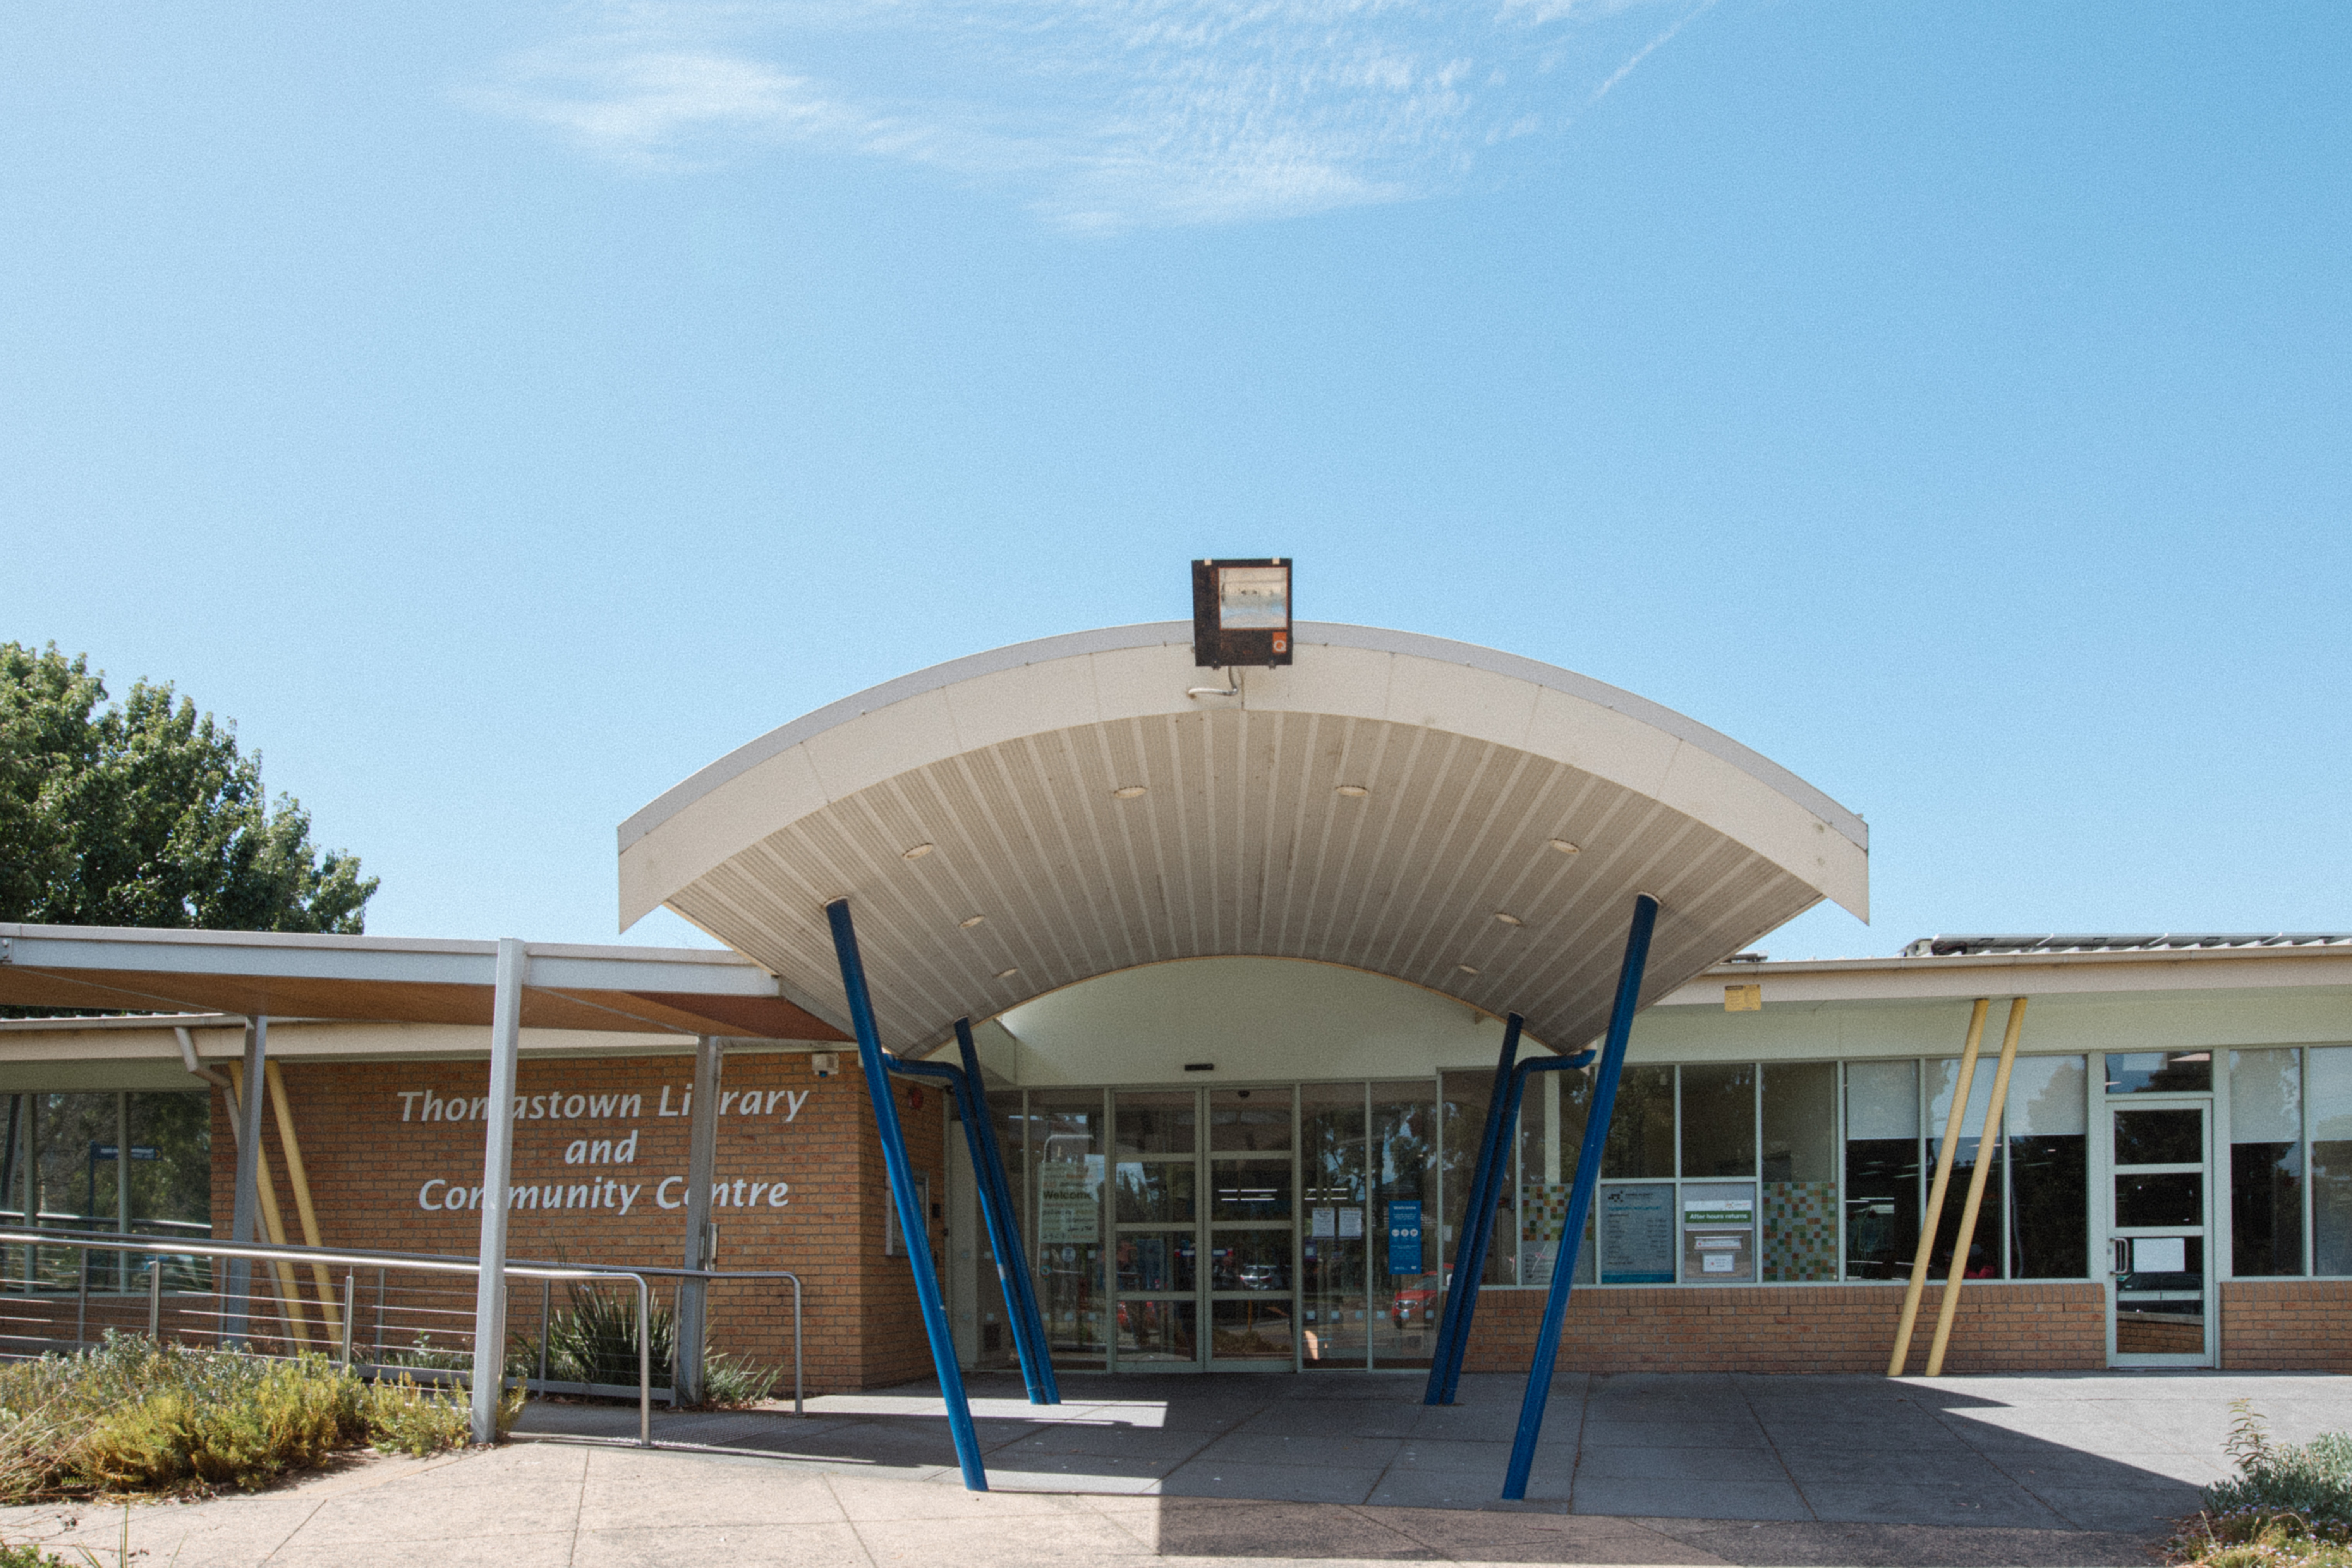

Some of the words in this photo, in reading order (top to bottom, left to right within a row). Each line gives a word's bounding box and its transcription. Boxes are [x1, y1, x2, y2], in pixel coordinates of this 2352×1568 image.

[659, 1083, 809, 1122] Lirary
[565, 1129, 639, 1164] and
[656, 1176, 788, 1209] Cntre
[1043, 1190, 1094, 1200] Welcome
